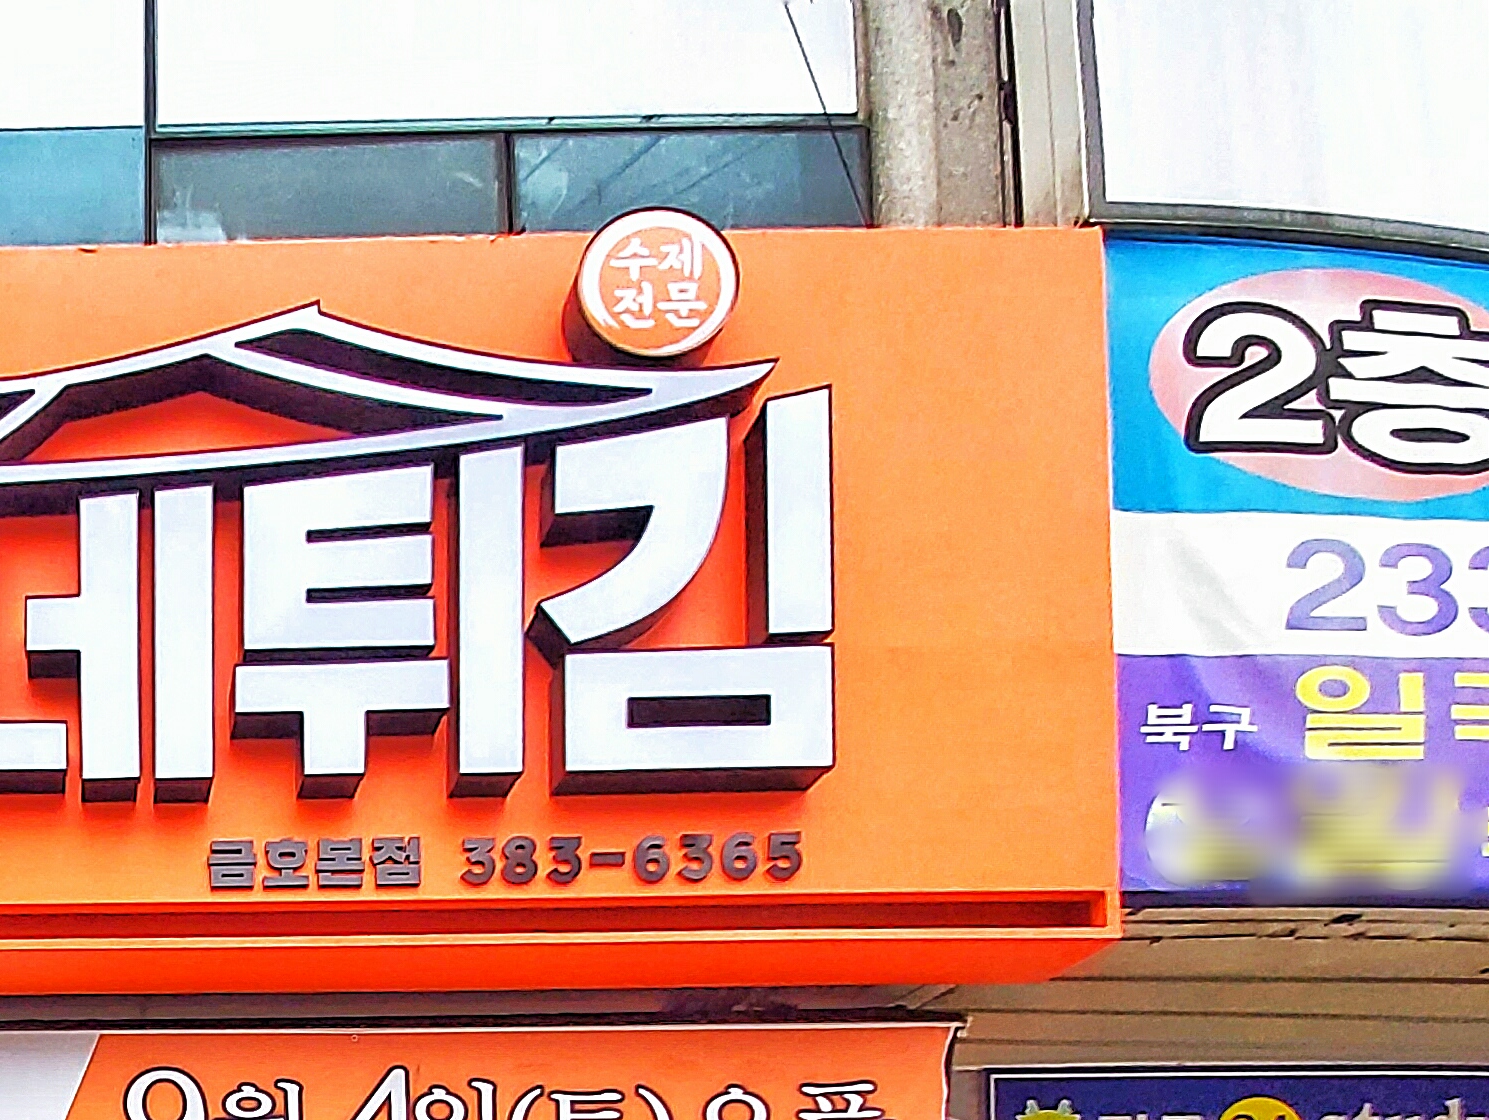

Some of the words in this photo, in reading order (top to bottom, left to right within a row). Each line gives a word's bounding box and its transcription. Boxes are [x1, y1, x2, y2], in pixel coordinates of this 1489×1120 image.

[609, 237, 704, 280] 수제
[612, 281, 708, 329] 전문
[1183, 299, 1489, 475] 2층
[1284, 538, 1489, 636] 23
[1140, 703, 1258, 751] 북구
[1295, 665, 1489, 760] 일
[207, 835, 421, 890] 금호본점
[459, 832, 803, 886] 383-6365
